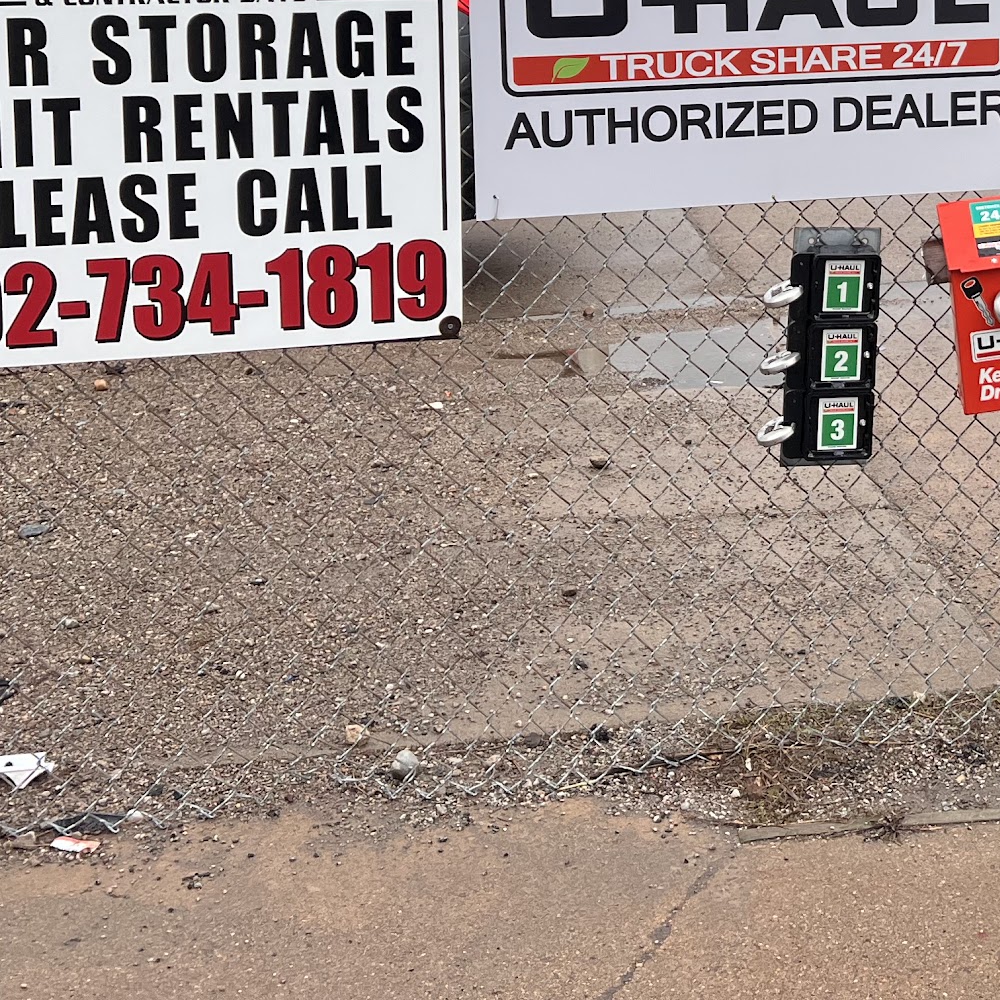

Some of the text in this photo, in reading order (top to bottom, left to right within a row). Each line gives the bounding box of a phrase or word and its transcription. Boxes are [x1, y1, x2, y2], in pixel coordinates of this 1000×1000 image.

[91, 10, 415, 85] STORAGE
[600, 41, 968, 80] TRUCK SHARE 24/7
[0, 86, 424, 168] IT RENTALS
[504, 98, 818, 150] AUTHORIZED
[0, 164, 392, 248] LEASE CALL
[0, 238, 447, 348] 2-734-1819
[836, 281, 848, 303] 1
[833, 350, 849, 372] 2
[830, 418, 845, 441] 3
